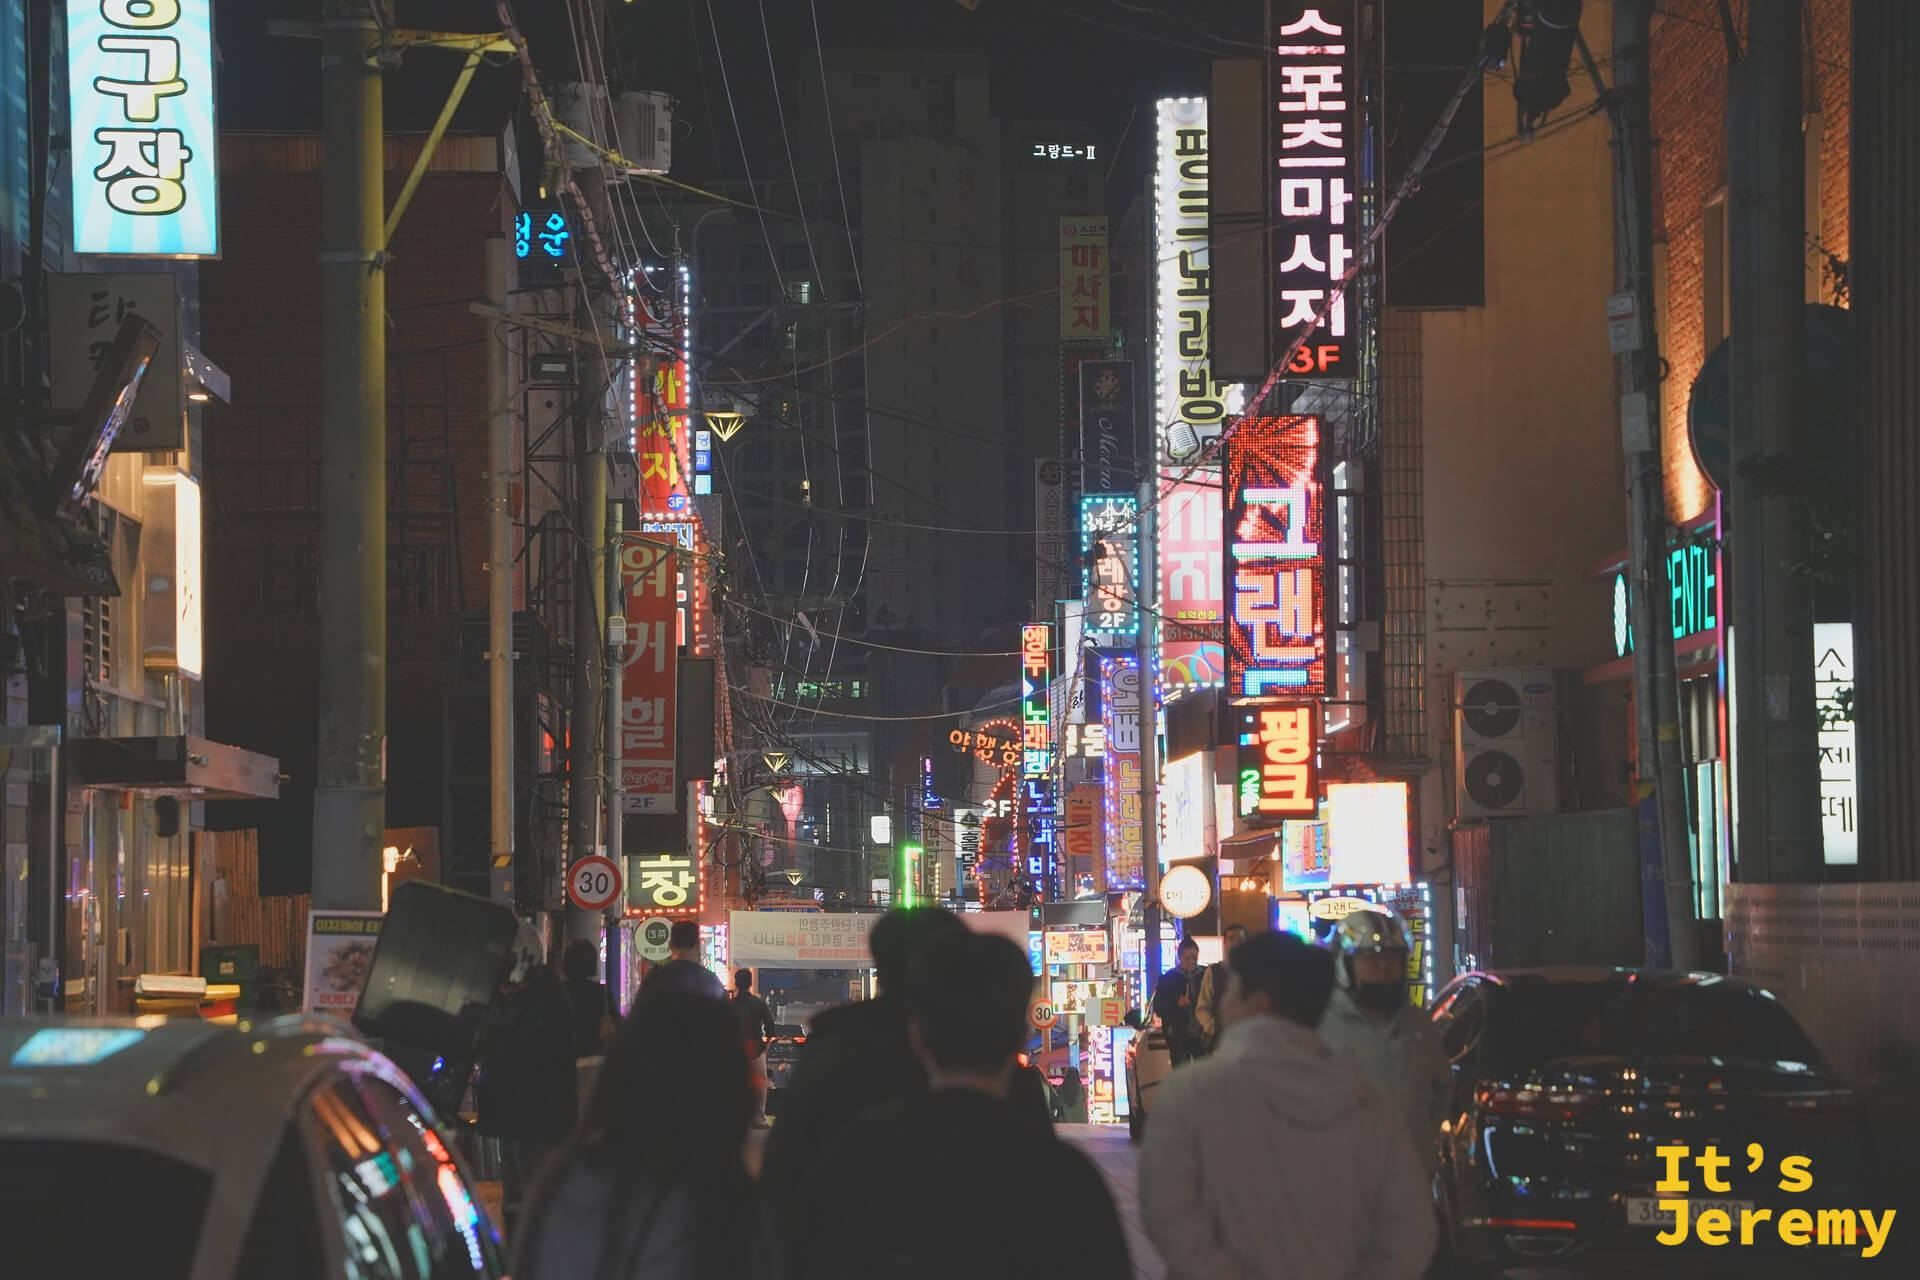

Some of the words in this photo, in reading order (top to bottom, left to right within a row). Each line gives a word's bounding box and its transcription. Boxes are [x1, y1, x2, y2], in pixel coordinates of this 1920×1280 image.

[1277, 8, 1353, 337] 스포츠마사지
[1071, 244, 1102, 331] 마사지
[1288, 345, 1340, 374] 3F
[668, 496, 685, 508] 3F
[1100, 613, 1126, 628] 2F
[1259, 707, 1315, 811] 핑크
[630, 797, 657, 808] 2F
[983, 800, 1011, 818] 2F
[579, 871, 609, 895] 30
[1035, 1007, 1051, 1020] 30
